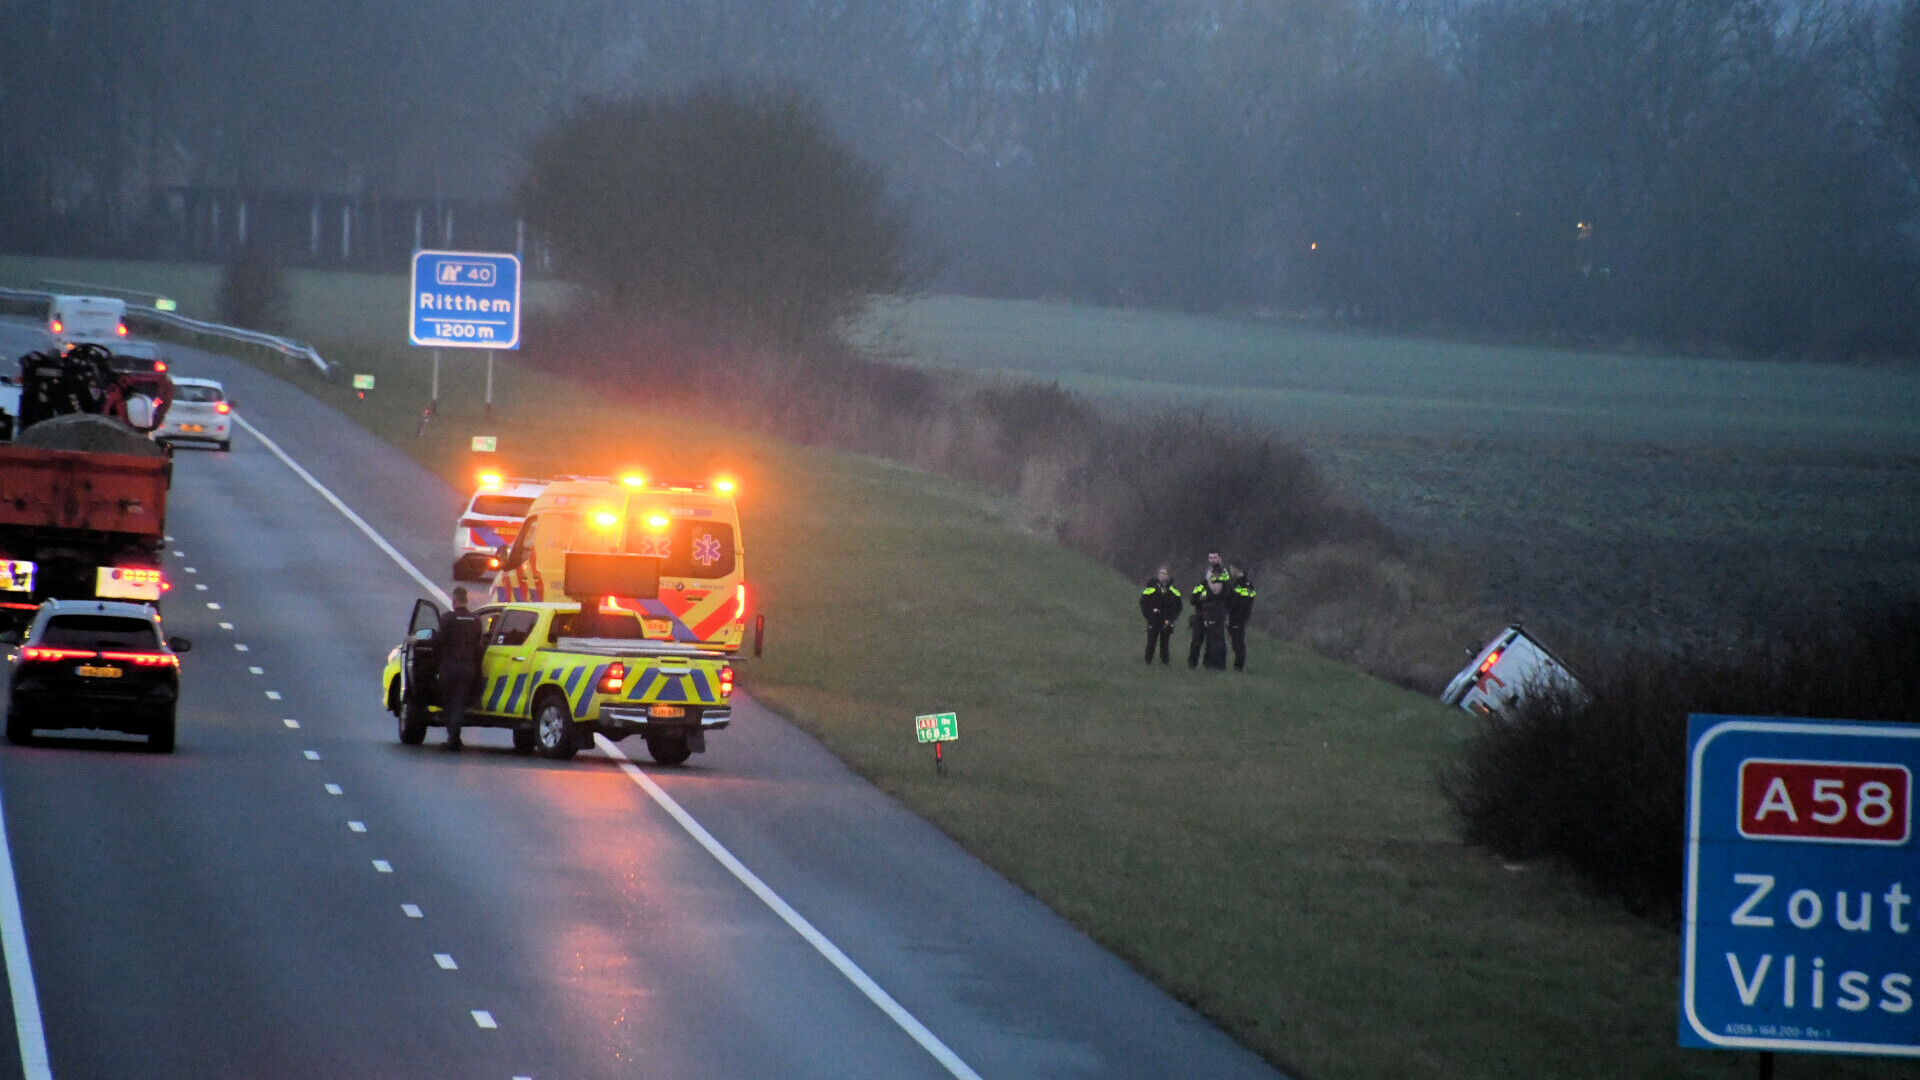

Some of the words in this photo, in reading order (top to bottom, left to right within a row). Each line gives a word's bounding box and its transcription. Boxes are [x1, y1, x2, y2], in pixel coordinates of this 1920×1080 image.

[468, 268, 491, 281] 40
[420, 293, 511, 313] Ritthem
[435, 324, 476, 338] 1200
[478, 326, 494, 339] m
[1754, 777, 1893, 826] A58
[1730, 872, 1911, 934] Zout
[1725, 952, 1914, 1014] Vliss
